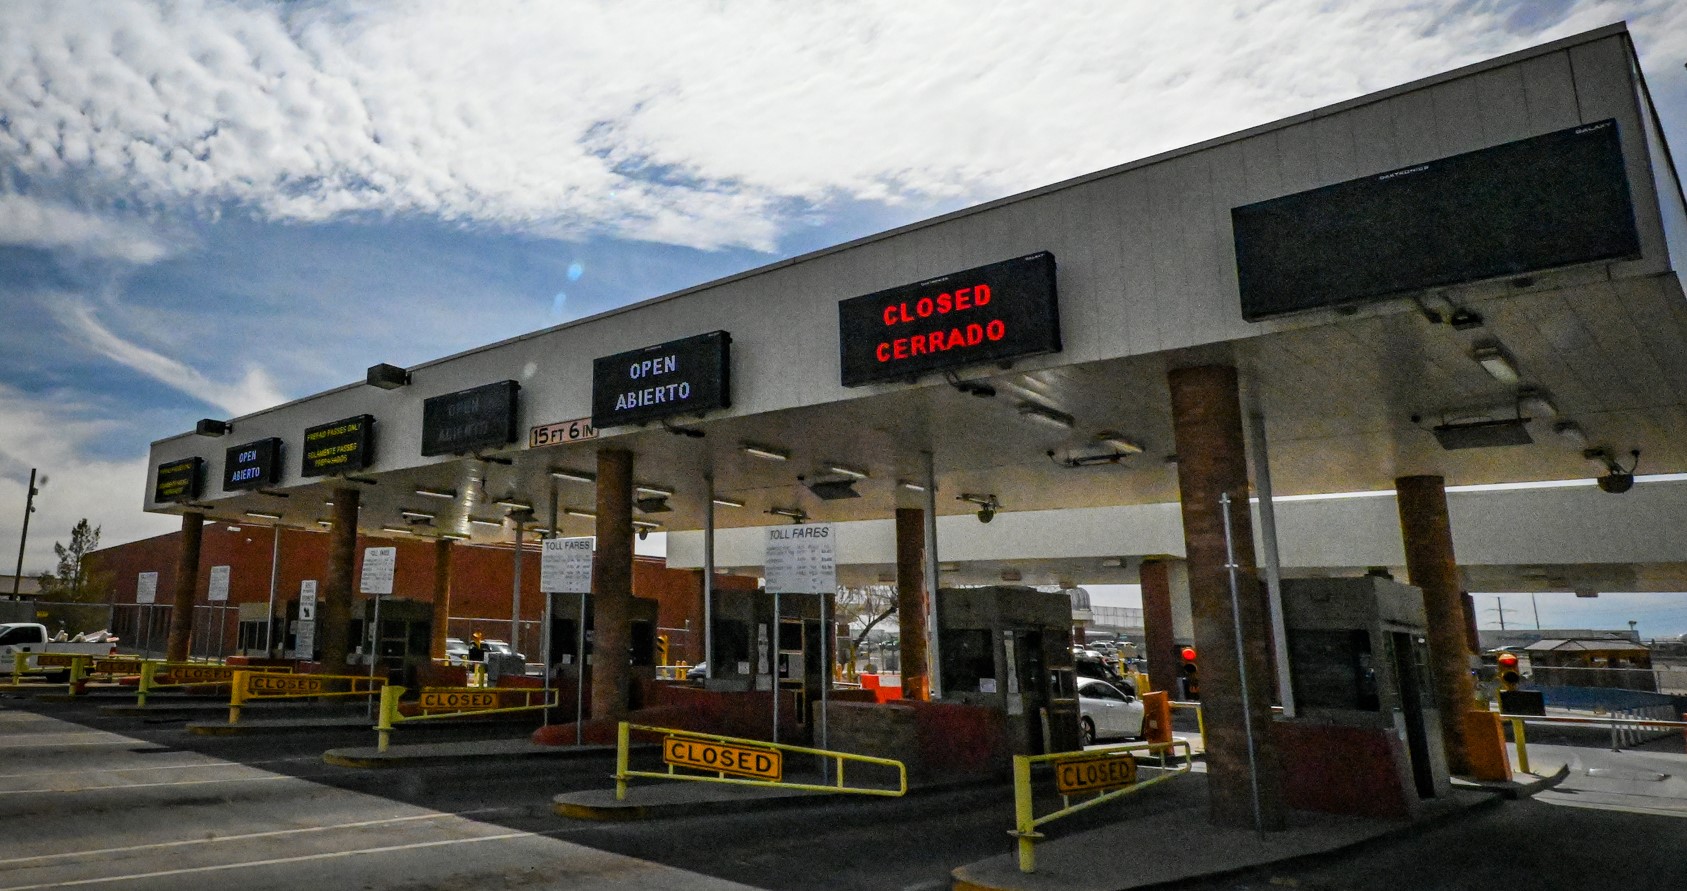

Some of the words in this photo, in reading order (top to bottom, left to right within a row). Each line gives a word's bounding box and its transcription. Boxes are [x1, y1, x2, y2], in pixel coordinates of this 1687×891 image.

[883, 284, 991, 326] CLOSED
[876, 319, 1005, 363] CERRADO
[629, 355, 676, 380] OPEN
[614, 382, 690, 411] ABIERTO
[327, 425, 347, 436] PASSES
[347, 422, 361, 432] ONLY
[533, 427, 549, 445] 15
[551, 428, 564, 442] FT
[569, 421, 580, 439] 6
[582, 424, 594, 438] IN
[238, 450, 257, 463] OPEN
[231, 466, 260, 482] ABIERTO
[770, 529, 790, 540] TOLL
[792, 526, 829, 538] FARES
[545, 542, 562, 551] TOLL
[564, 540, 590, 550] FARES
[174, 669, 232, 678] CLOSED
[253, 677, 319, 691] CLOSED
[424, 693, 494, 708] CLOSED
[671, 743, 772, 773] CLOSED
[1061, 763, 1130, 787] CLOSED
